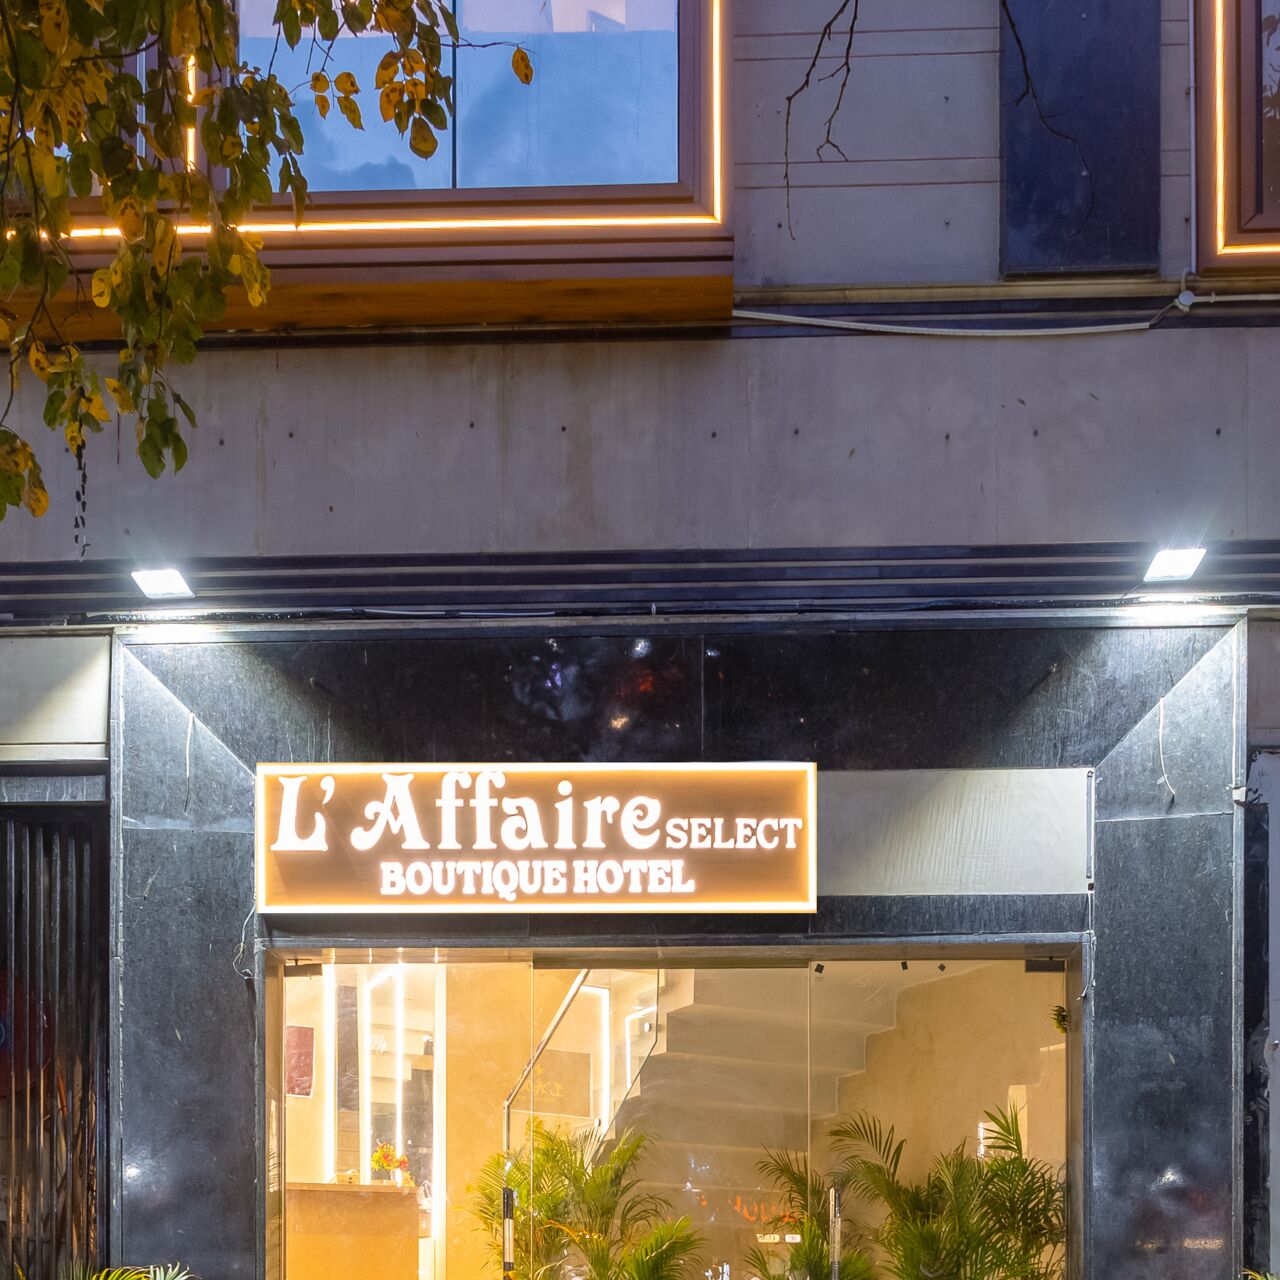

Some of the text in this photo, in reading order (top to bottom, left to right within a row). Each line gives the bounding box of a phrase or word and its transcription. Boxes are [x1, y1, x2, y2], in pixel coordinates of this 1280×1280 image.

[665, 817, 803, 850] SELECT
[380, 858, 695, 901] BOUTIQUE HOTEL
